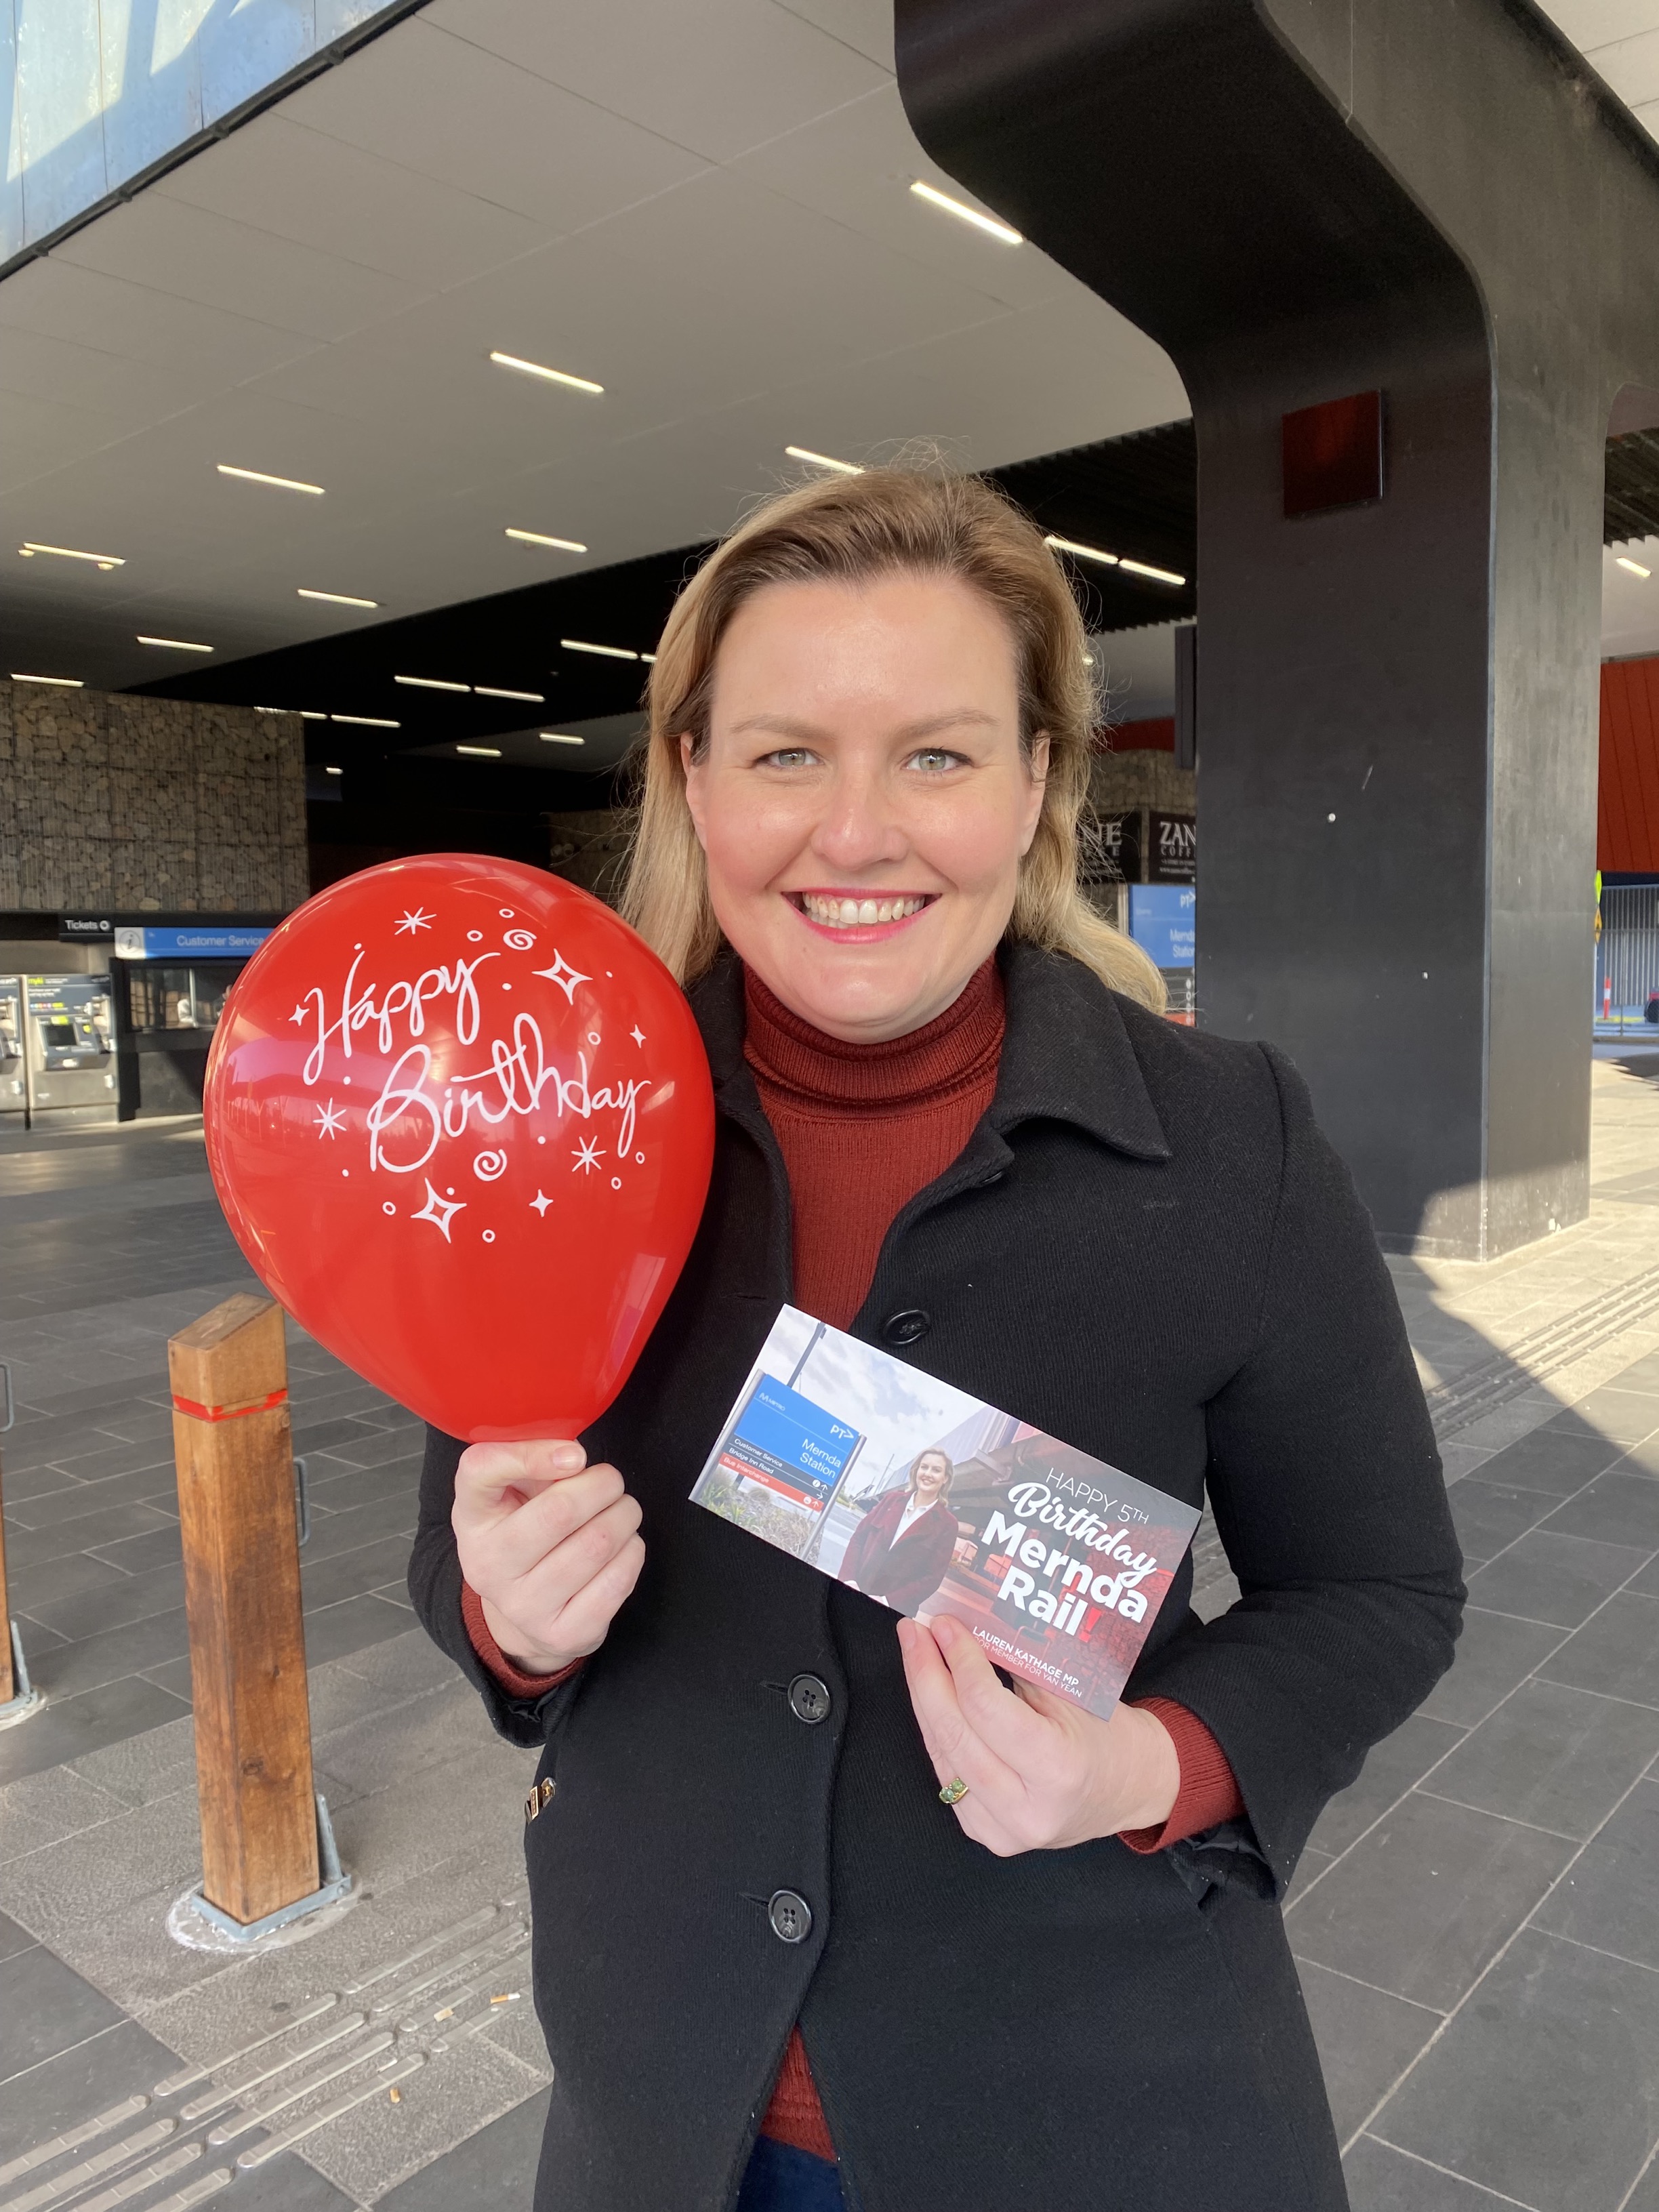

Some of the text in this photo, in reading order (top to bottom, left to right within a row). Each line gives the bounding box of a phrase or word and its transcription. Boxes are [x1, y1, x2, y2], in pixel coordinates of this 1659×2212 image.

[1160, 821, 1195, 846] ZAN
[1161, 845, 1195, 857] COFF
[64, 920, 98, 930] Tickets
[176, 935, 264, 947] Customer Service
[303, 950, 501, 1086] Happy
[367, 1012, 653, 1173] Birthday
[729, 1447, 775, 1474] Bridge Inn Road
[734, 1438, 783, 1468] Customer Service
[800, 1452, 836, 1479] Station
[802, 1438, 842, 1469] Mernda
[723, 1457, 770, 1483] Bus Interchange
[1045, 1467, 1149, 1525] HAPPY 5TH
[1008, 1481, 1158, 1589] Birthday
[981, 1510, 1149, 1624] Mernda
[997, 1565, 1103, 1643] Rail!
[972, 1626, 1080, 1686] LAUREN KATHAGE MP
[990, 1645, 1024, 1668] MEMBER
[1024, 1664, 1042, 1677] FOR
[1043, 1673, 1059, 1685] YAN
[1060, 1681, 1082, 1698] YEAN
